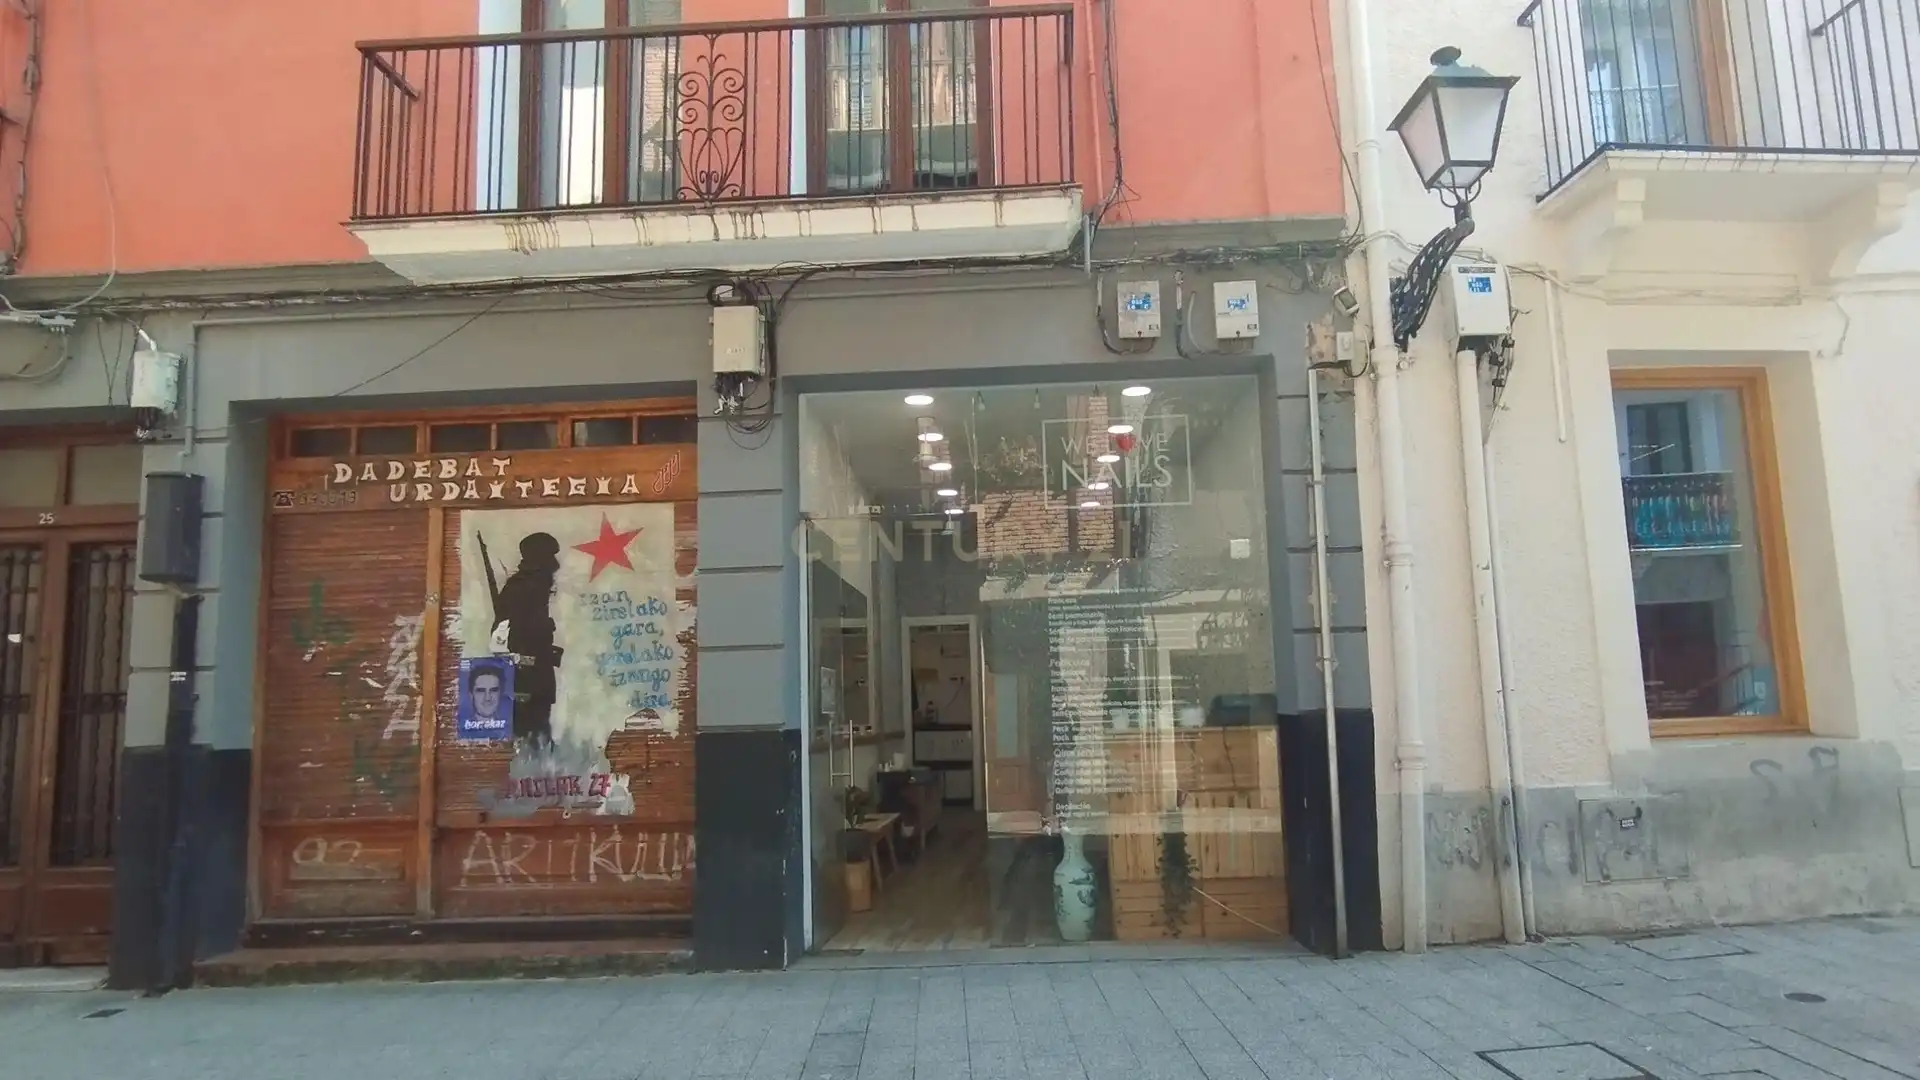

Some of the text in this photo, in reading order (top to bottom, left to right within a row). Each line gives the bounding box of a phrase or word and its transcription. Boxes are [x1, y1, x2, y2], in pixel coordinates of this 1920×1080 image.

[334, 457, 512, 484] DADEBAT
[1061, 454, 1173, 491] NAILS
[38, 511, 55, 525] 25
[590, 772, 611, 797] 27
